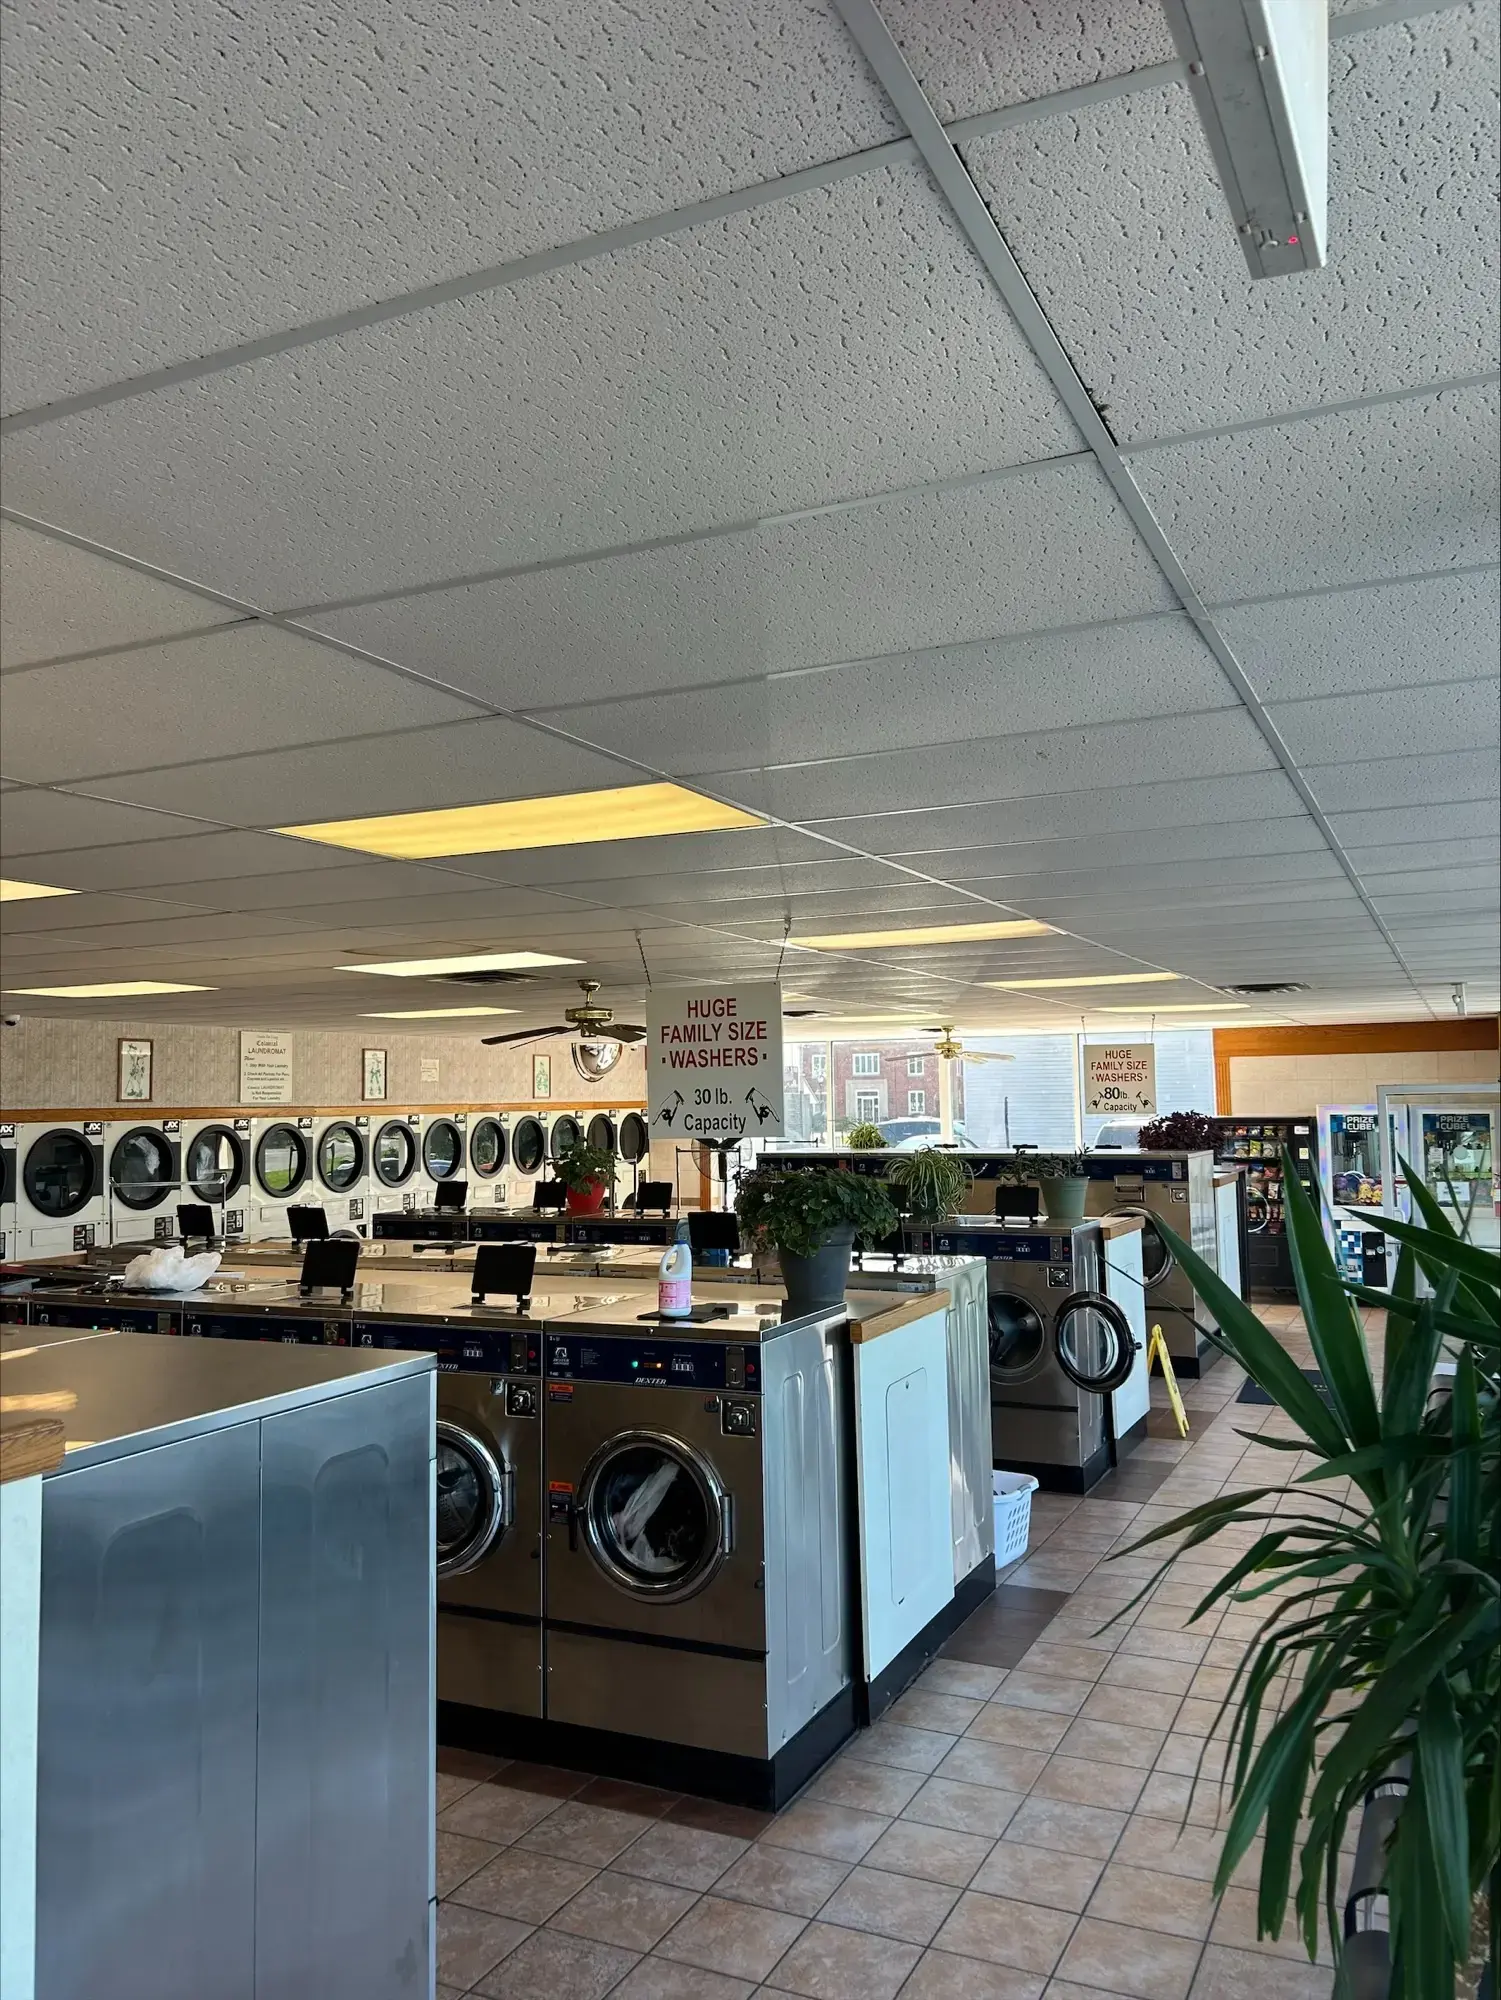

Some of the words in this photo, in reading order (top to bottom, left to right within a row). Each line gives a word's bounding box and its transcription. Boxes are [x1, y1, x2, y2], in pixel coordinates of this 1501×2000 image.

[687, 998, 737, 1018] HUGE
[660, 1022, 723, 1044] FAMILY
[728, 1020, 768, 1041] SIZE
[669, 1047, 758, 1068] WASHERS
[1105, 1050, 1132, 1059] HUGE
[1091, 1061, 1124, 1070] FAMILY
[1126, 1060, 1148, 1070] SIZE
[1095, 1072, 1143, 1082] WASHERS
[694, 1088, 711, 1105] 30
[715, 1088, 732, 1104] lb.
[1104, 1087, 1120, 1100] 80
[1104, 1102, 1137, 1112] Capacity
[684, 1112, 747, 1134] Capacity
